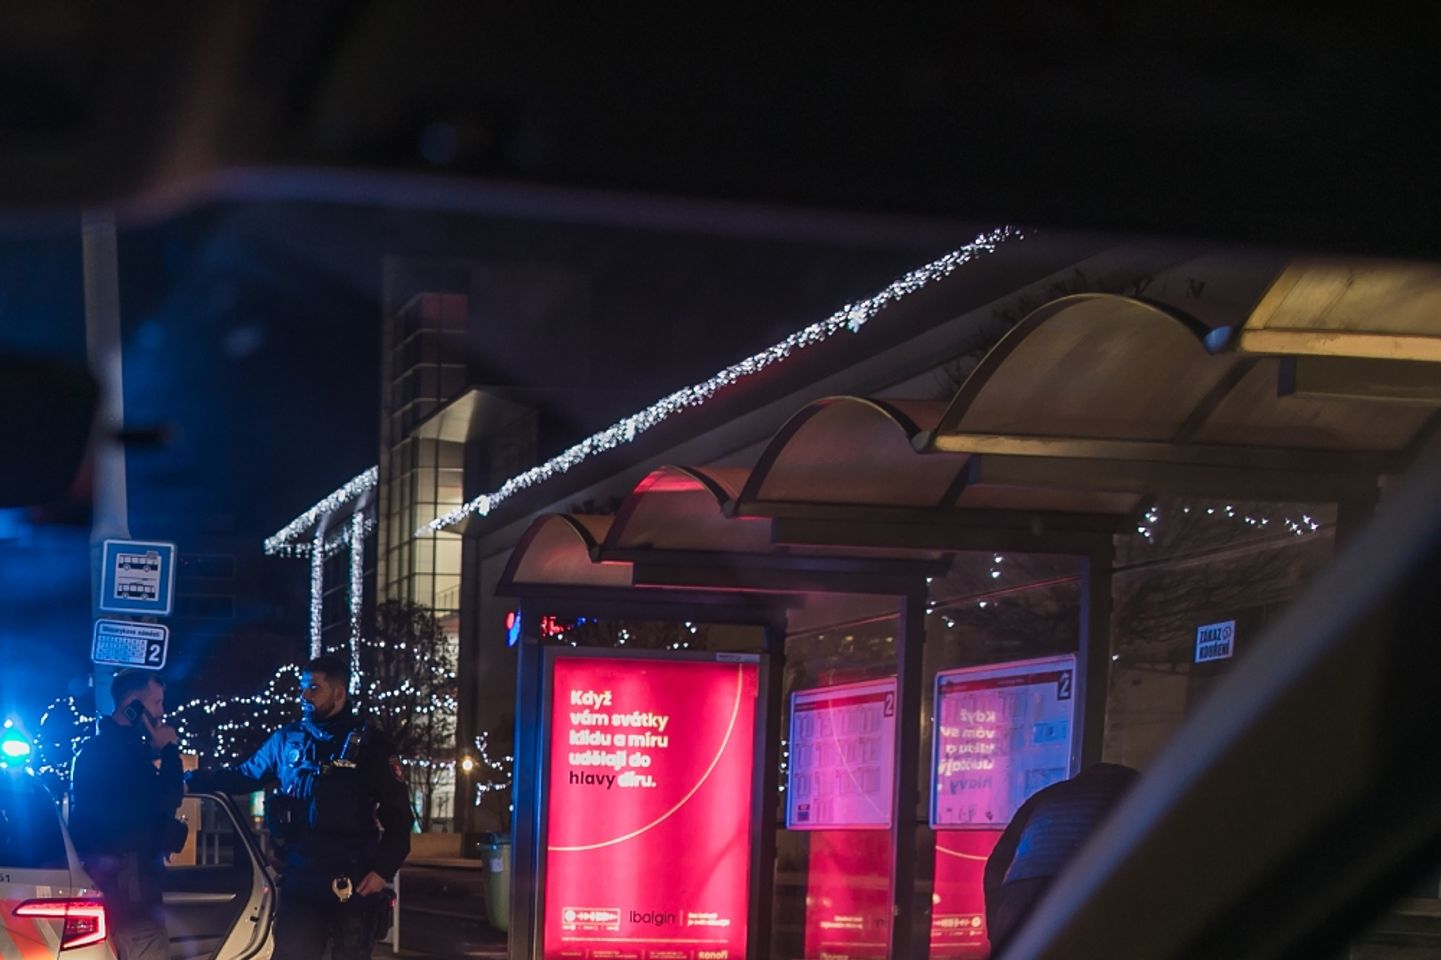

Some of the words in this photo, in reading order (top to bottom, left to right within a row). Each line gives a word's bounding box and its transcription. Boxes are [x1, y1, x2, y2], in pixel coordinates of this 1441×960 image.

[148, 644, 161, 662] 2
[570, 689, 613, 710] Když
[885, 693, 894, 715] 2
[569, 709, 609, 726] vám
[611, 711, 669, 732] svátky
[569, 729, 612, 746] klidu
[613, 733, 626, 747] a
[627, 731, 669, 748] míru
[568, 750, 627, 771] udělají
[628, 751, 651, 767] do
[569, 770, 616, 790] hlavy
[617, 770, 657, 788] díru.
[698, 950, 729, 960] sanofi
